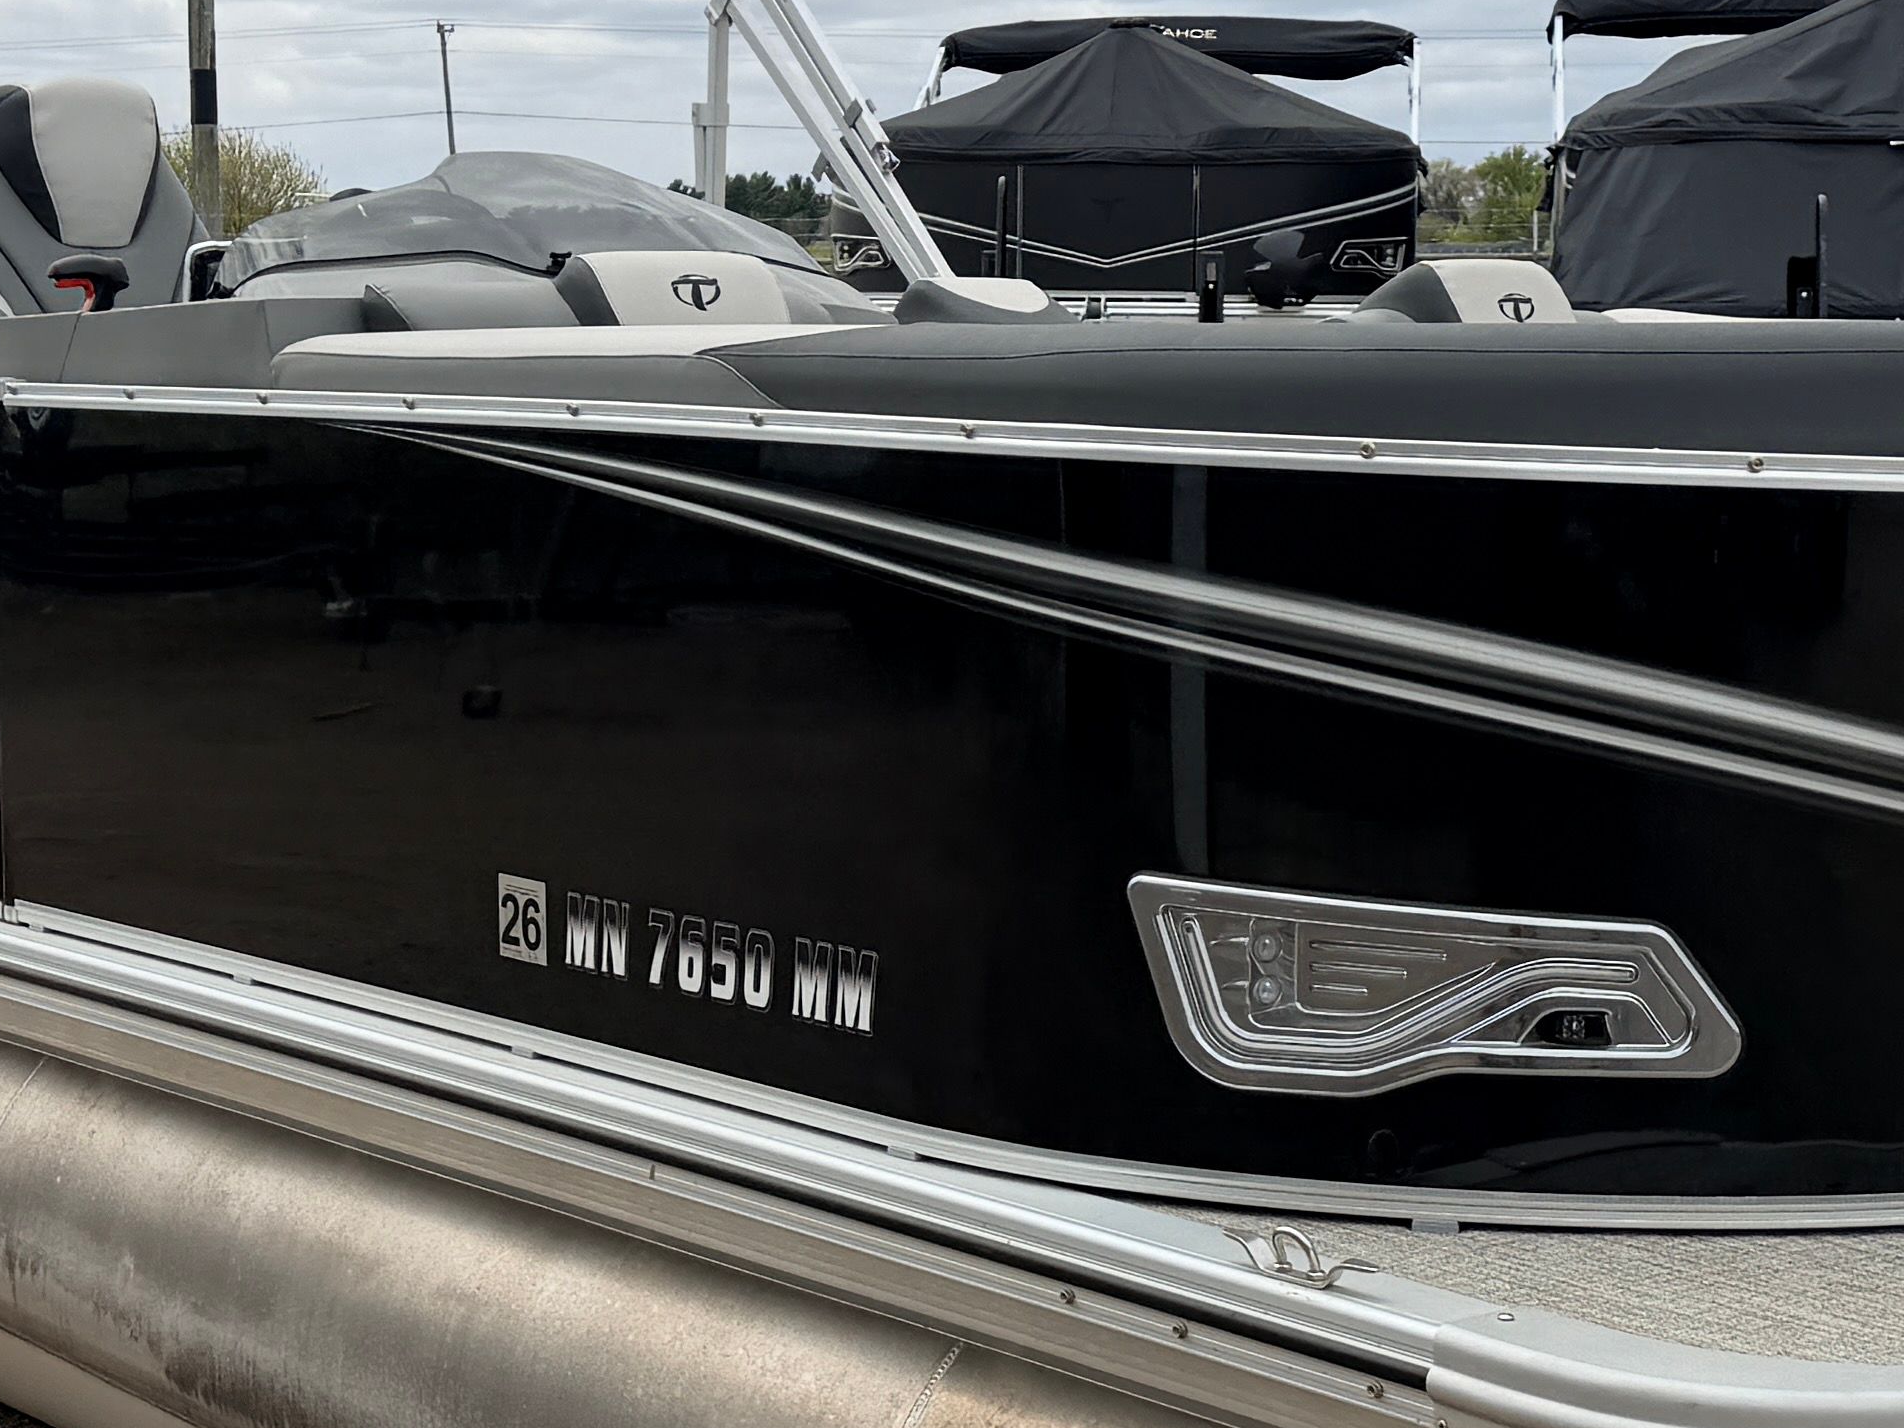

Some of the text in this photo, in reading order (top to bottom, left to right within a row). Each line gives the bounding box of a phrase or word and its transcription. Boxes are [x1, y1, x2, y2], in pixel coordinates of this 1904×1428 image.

[501, 892, 541, 951] 26
[565, 891, 879, 1036] MN 7650 MM
